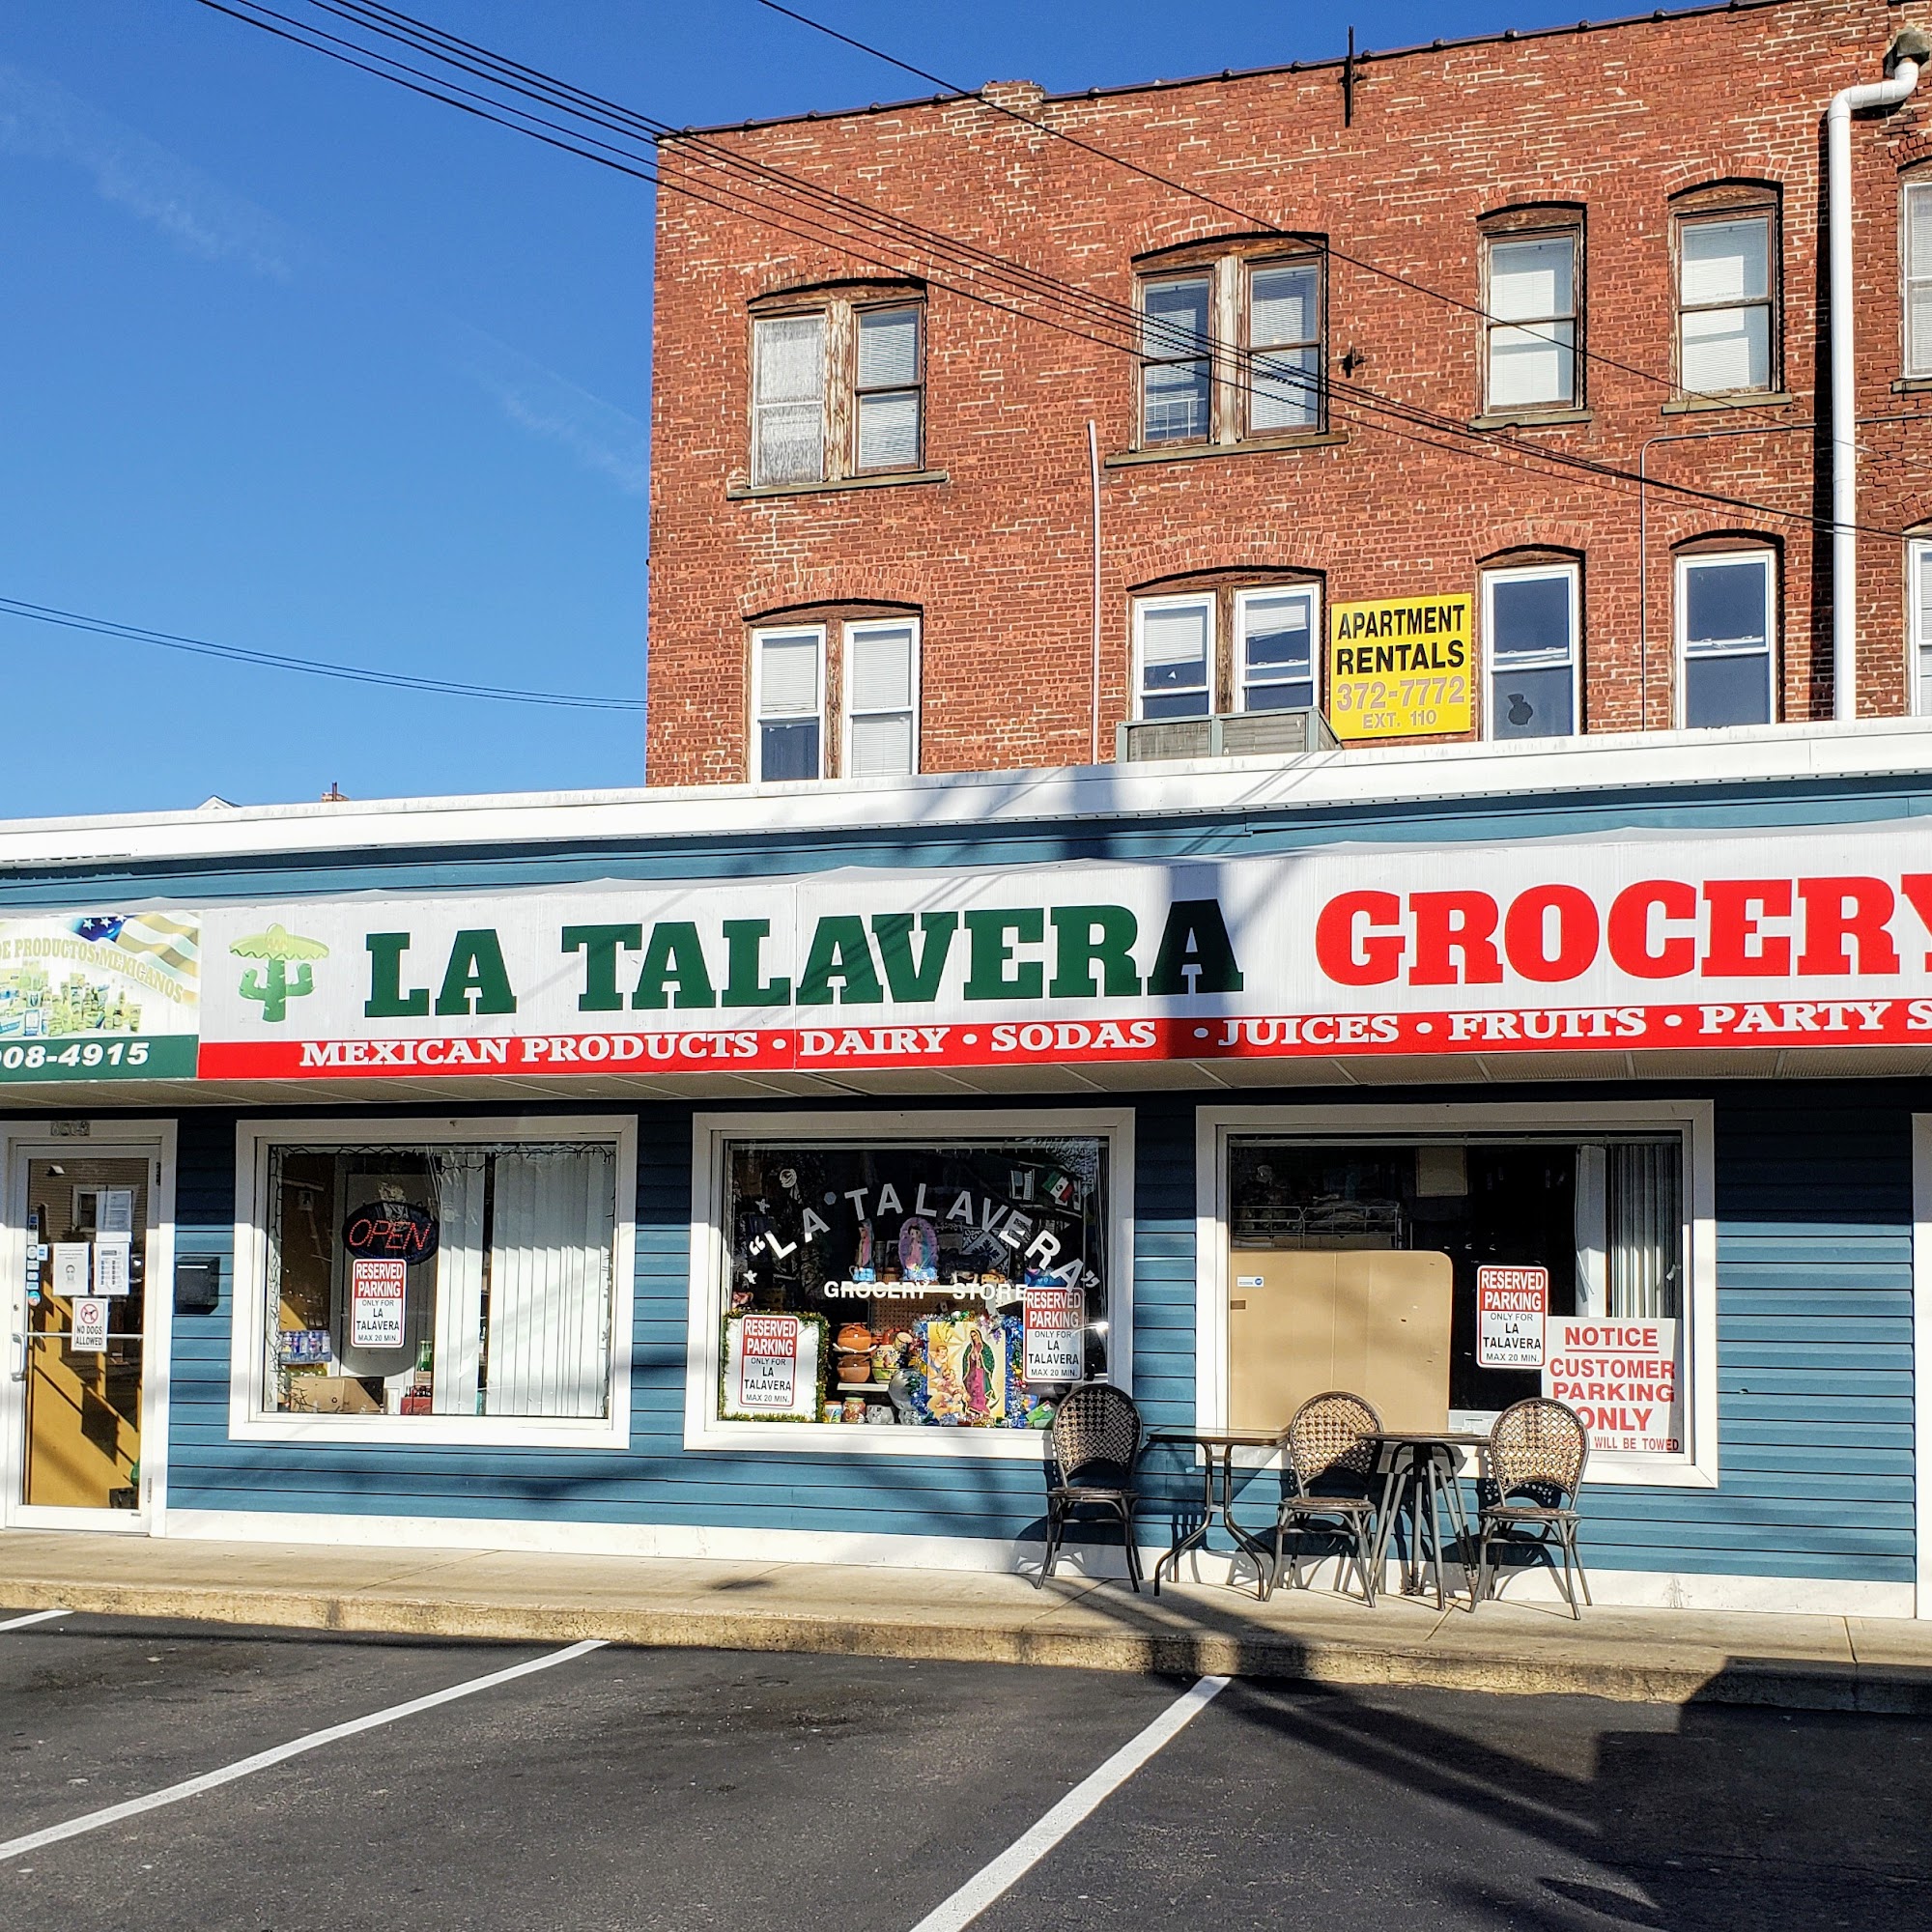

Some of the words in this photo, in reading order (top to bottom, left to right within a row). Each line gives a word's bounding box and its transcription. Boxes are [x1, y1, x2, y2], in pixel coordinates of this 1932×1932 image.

[1337, 604, 1465, 640] APARTMENT
[1336, 639, 1464, 675] RENTALS
[1336, 675, 1465, 711] 372-7772
[1362, 712, 1401, 729] EXT.
[1409, 709, 1437, 726] 110
[364, 928, 518, 1018] LA
[561, 898, 1244, 1012] TALAVERA
[14, 937, 98, 965] PRODUCTOS
[98, 948, 185, 1004] MEXICANOS
[300, 1037, 511, 1067] MEXICAN
[521, 1031, 759, 1063] PRODUCTS
[799, 1026, 953, 1057] DAIRY
[990, 1020, 1158, 1053] SODAS
[1217, 1014, 1400, 1047] JUICES
[1447, 1007, 1648, 1040] FRUITS
[1697, 1000, 1892, 1035] PARTY
[0, 1041, 151, 1069] 08-4915
[350, 1219, 432, 1250] OPEN
[355, 1263, 403, 1280] RESERVED
[1481, 1270, 1545, 1291] RESERVED
[357, 1281, 401, 1297] PARKING
[823, 1280, 930, 1300] GROCERY
[952, 1282, 1029, 1301] STORE
[1027, 1291, 1081, 1309] RESERVED
[1484, 1291, 1542, 1311] PARKING
[373, 1308, 384, 1318] LA
[1029, 1310, 1079, 1329] PARKING
[76, 1324, 85, 1334] NO
[86, 1325, 102, 1335] DOGS
[356, 1321, 399, 1330] TALAVERA
[745, 1319, 796, 1337] RESERVED
[1505, 1322, 1520, 1334] LA
[75, 1335, 102, 1346] ALLOWED
[1047, 1340, 1060, 1350] LA
[1483, 1337, 1542, 1350] TALAVERA
[1564, 1326, 1658, 1347] NOTICE
[747, 1337, 793, 1356] PARKING
[1028, 1353, 1079, 1365] TALAVERA
[1487, 1352, 1506, 1361] MAX
[762, 1366, 774, 1377] LA
[1549, 1357, 1675, 1379] CUSTOMER
[744, 1378, 791, 1391] TALAVERA
[1552, 1381, 1675, 1403] PARKING
[1576, 1406, 1653, 1431] ONLY
[1594, 1435, 1618, 1449] WILL
[1623, 1436, 1637, 1449] BE
[1642, 1437, 1679, 1451] TOWED
